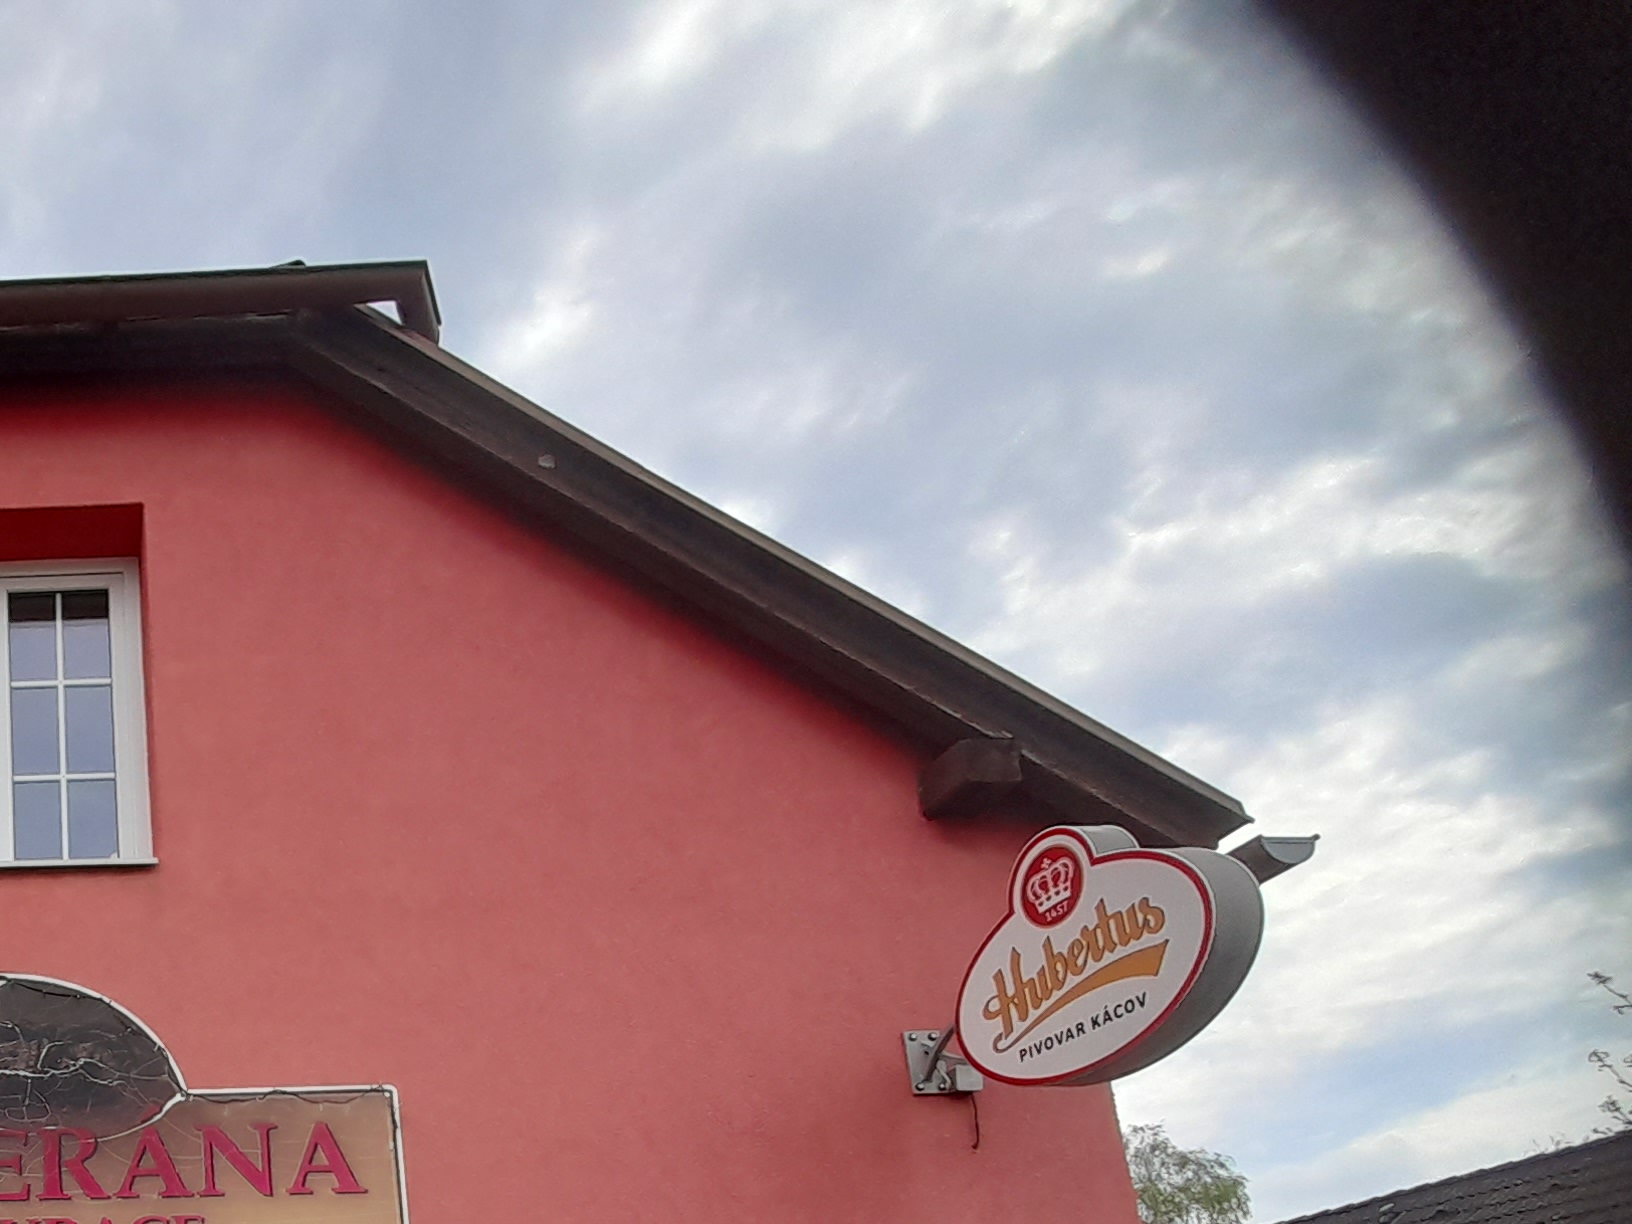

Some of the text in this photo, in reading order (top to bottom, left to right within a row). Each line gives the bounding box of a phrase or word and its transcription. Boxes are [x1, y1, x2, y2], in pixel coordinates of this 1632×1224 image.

[982, 896, 1165, 1040] Hubertus
[1018, 991, 1149, 1063] PIVOVAR KÁCOV
